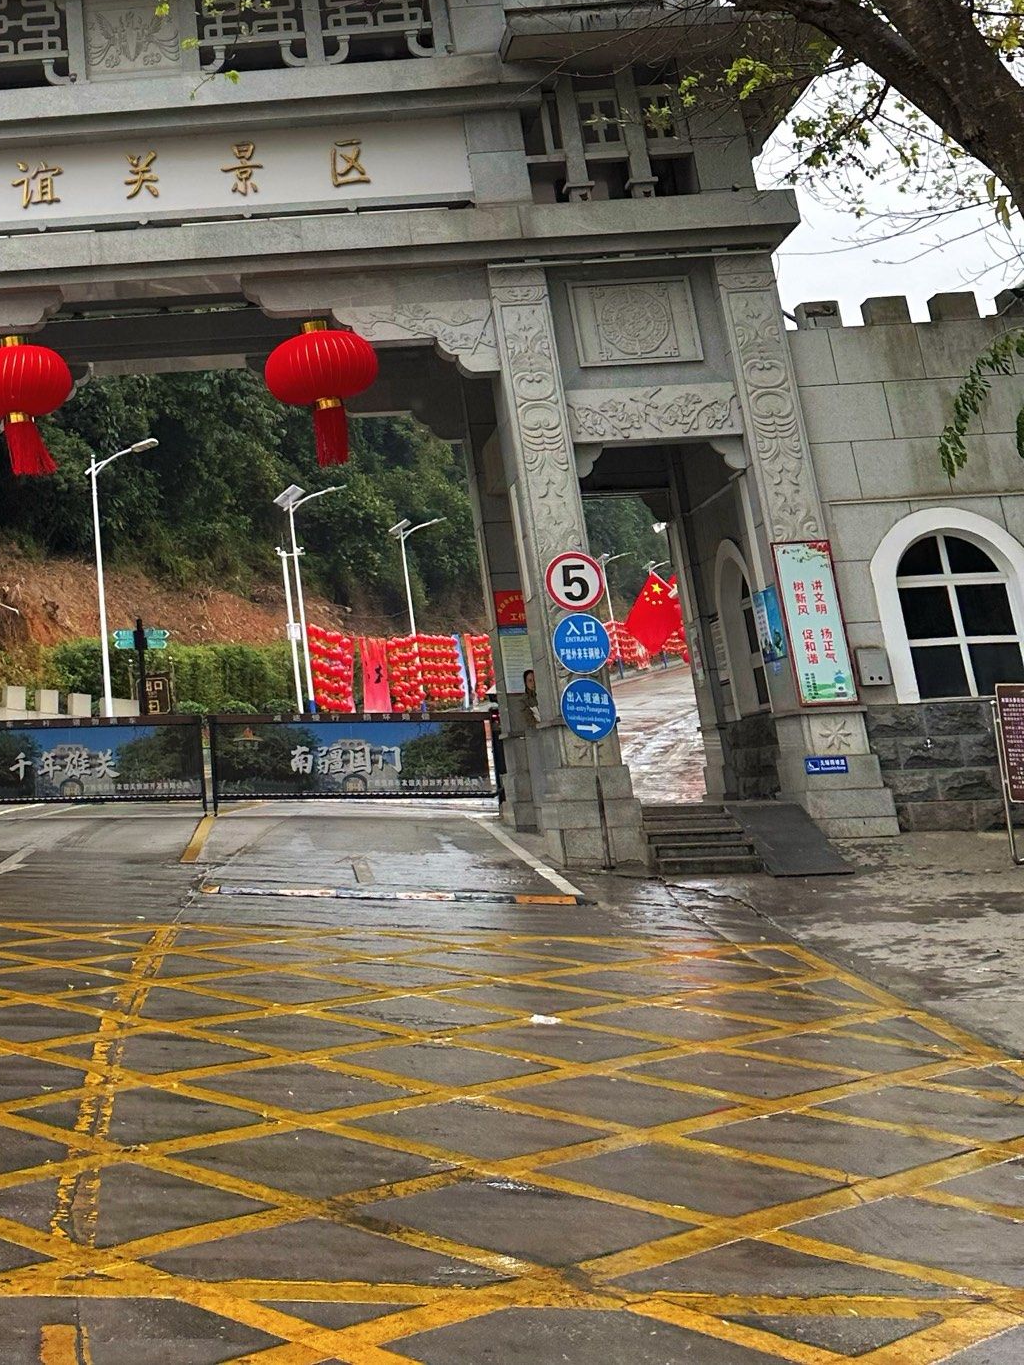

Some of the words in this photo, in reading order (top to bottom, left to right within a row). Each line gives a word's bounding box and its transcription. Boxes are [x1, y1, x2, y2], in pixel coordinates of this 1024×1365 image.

[562, 564, 590, 601] 5
[566, 621, 596, 635] 入口
[793, 581, 809, 616] 树新风
[802, 628, 819, 665] 促和谐
[811, 580, 828, 615] 讲文明
[820, 628, 837, 664] 扬正气
[566, 691, 609, 705] 出入境通道
[9, 748, 121, 781] 千年雄关
[289, 744, 403, 776] 南疆国门
